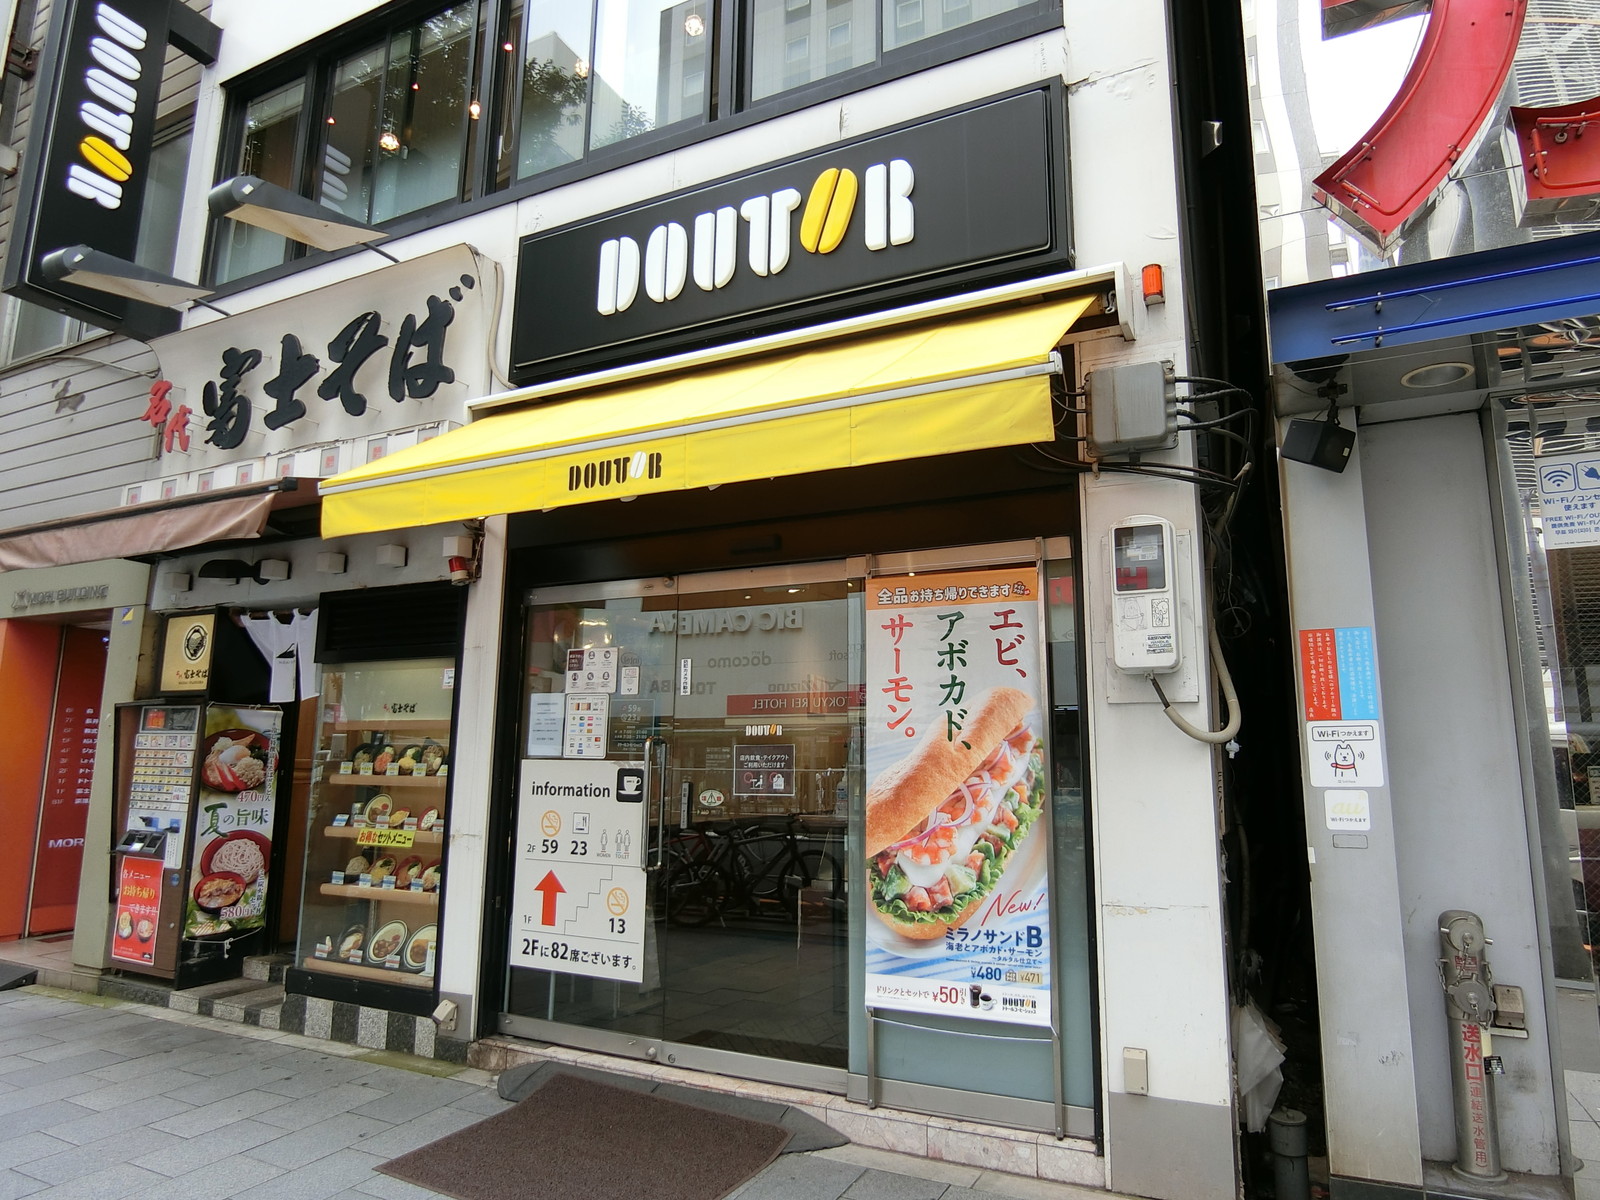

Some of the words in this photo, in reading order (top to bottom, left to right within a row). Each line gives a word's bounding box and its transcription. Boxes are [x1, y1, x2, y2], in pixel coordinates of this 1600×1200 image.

[69, 3, 147, 210] DOUTOR
[597, 159, 915, 316] DOUTOR
[141, 380, 193, 453] 名代
[202, 273, 475, 450] 富士そば
[568, 450, 662, 491] DOUTOR
[1564, 502, 1596, 511] 使えます
[56, 584, 110, 602] BUILDING
[877, 583, 1011, 605] 全品お持ち帰りできます
[989, 609, 1027, 678] エビ、
[881, 614, 915, 737] サーモン。
[937, 611, 972, 750] アボカド、
[745, 724, 783, 736] DOUTOR
[1317, 730, 1369, 738] Wi-Fiつかえます
[531, 781, 611, 798] information
[201, 802, 268, 838] 夏の旨味
[527, 844, 536, 852] 2F
[541, 839, 559, 854] 59
[570, 840, 588, 856] 23
[123, 885, 156, 899] お持ち帰り
[981, 888, 1045, 927] New!
[523, 914, 532, 924] 1F
[608, 917, 626, 934] 13
[945, 925, 1043, 948] ミラノサンドB
[521, 938, 637, 971] 2Fに82席ございます。
[945, 941, 1043, 958] 海老とアボカド・サーモン
[971, 966, 1002, 981] ¥480
[1020, 972, 1041, 983] ¥471
[876, 985, 930, 999] ドリンクとセットで
[932, 985, 959, 1004] ¥50
[1002, 997, 1037, 1009] DOUTOR
